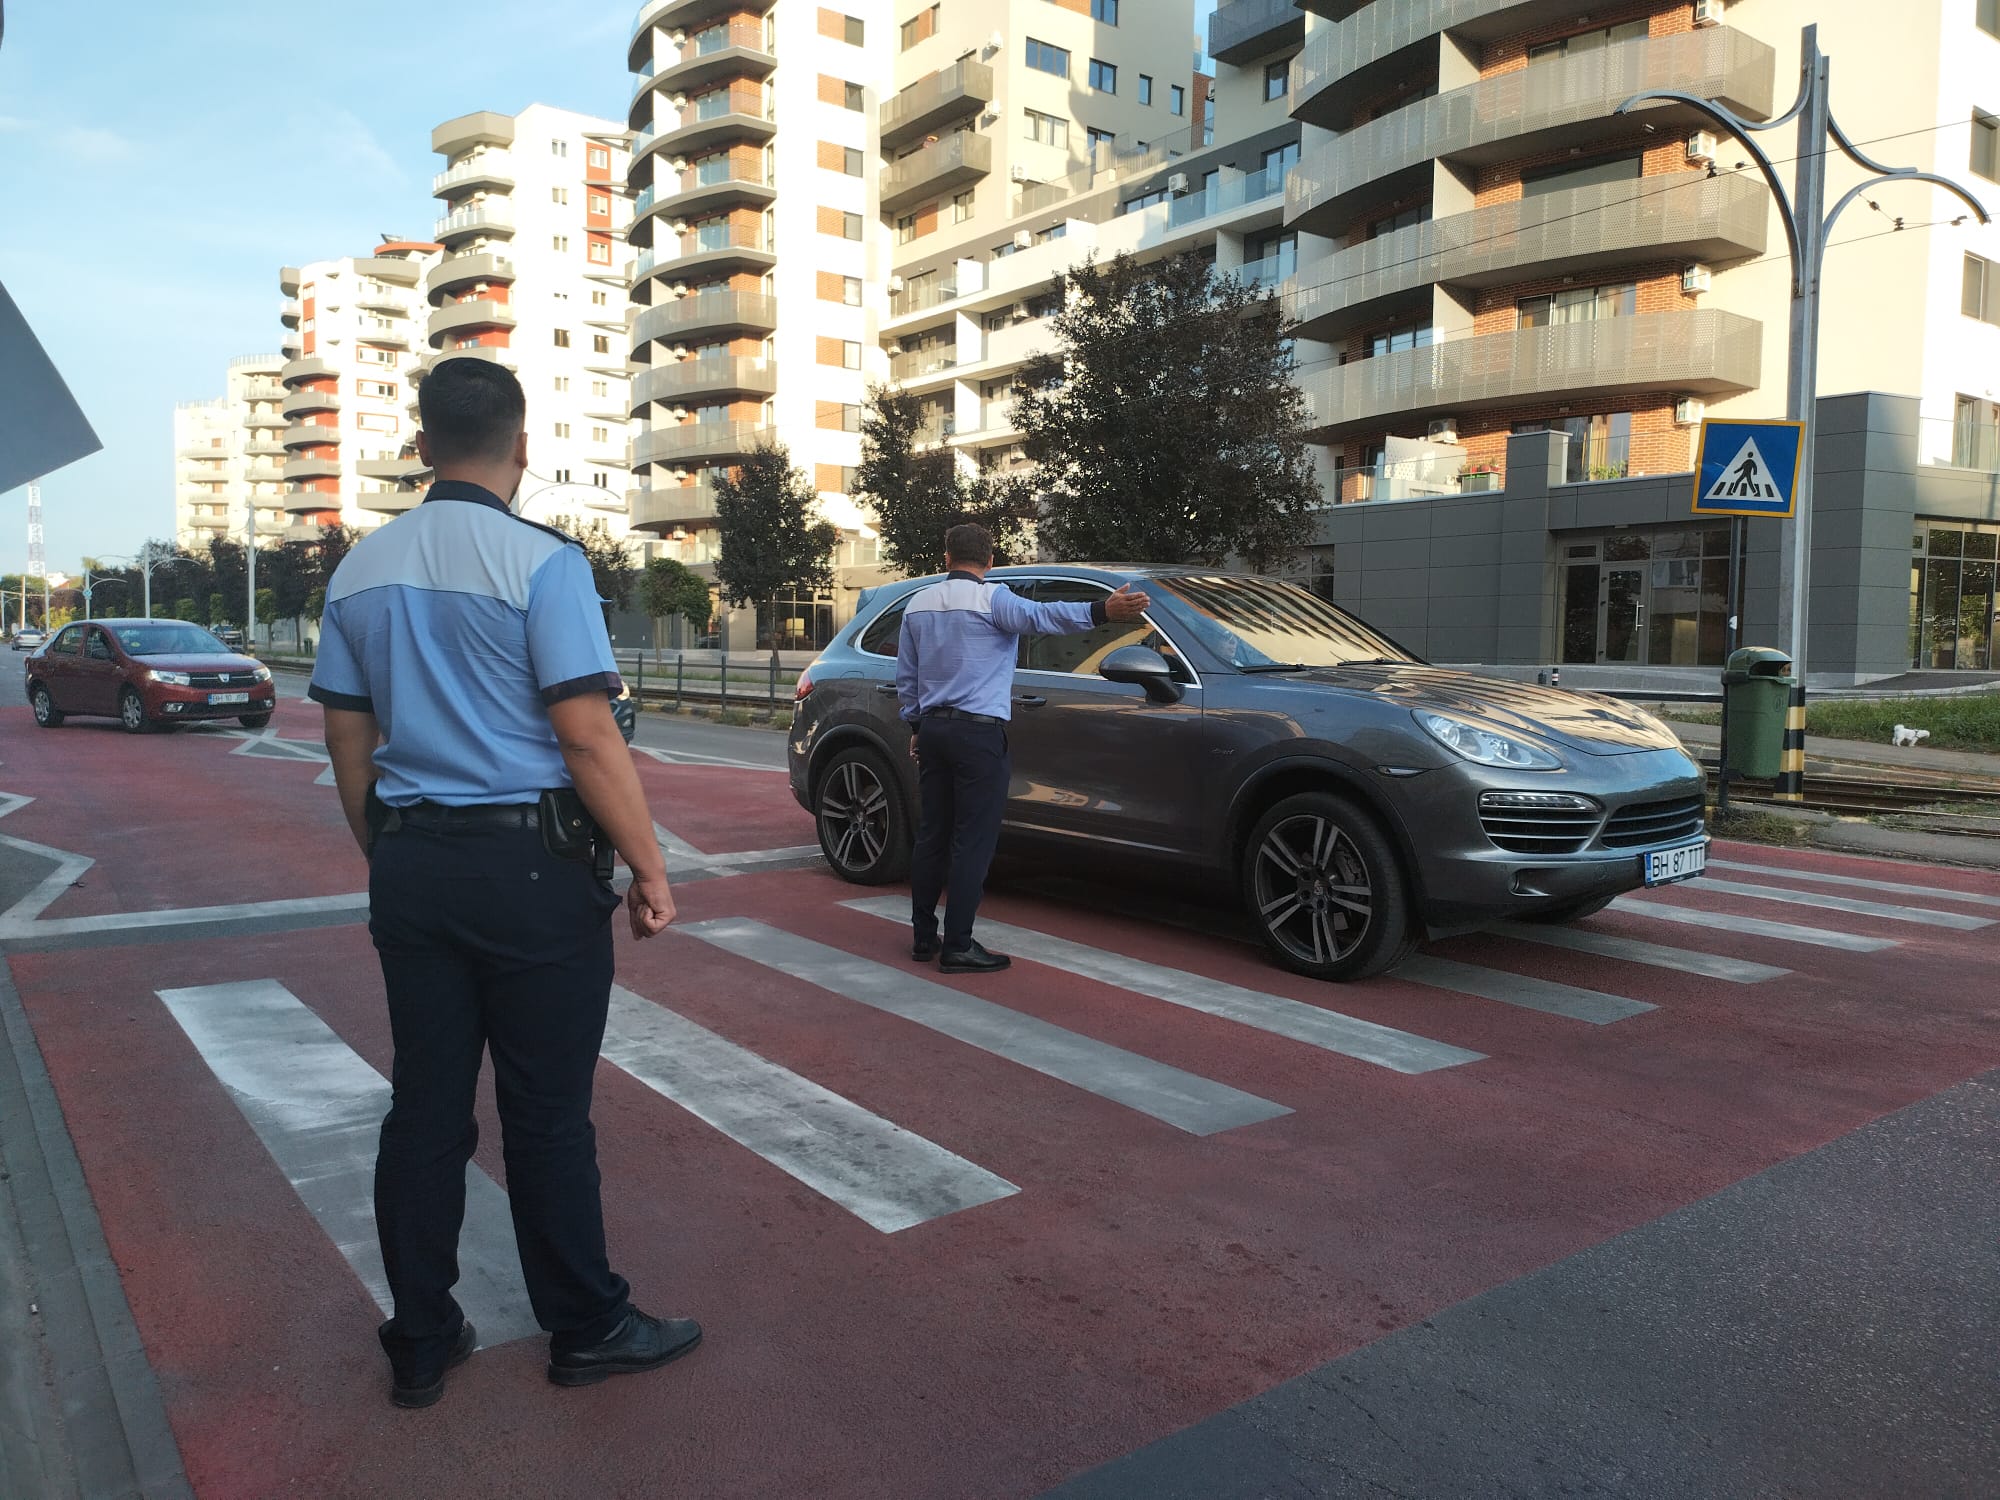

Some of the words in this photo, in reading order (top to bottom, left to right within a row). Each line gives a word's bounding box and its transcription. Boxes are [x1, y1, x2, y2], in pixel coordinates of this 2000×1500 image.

[1652, 854, 1669, 877] BH
[1673, 851, 1685, 873] 87
[1688, 847, 1703, 870] TTT
